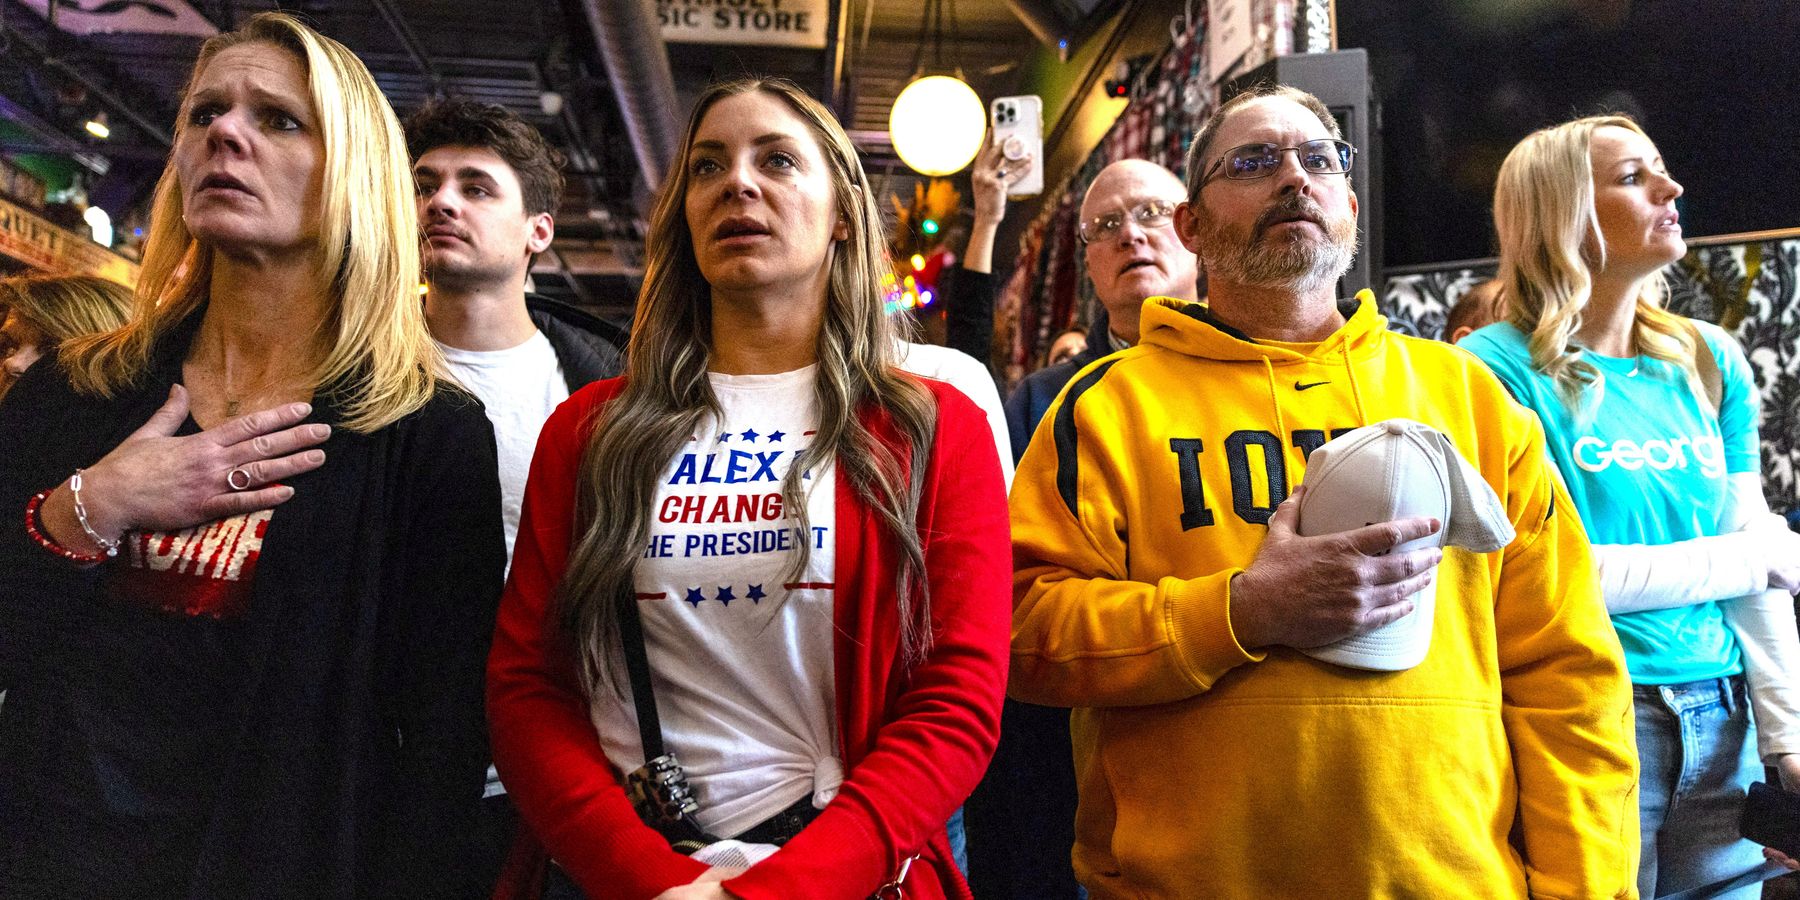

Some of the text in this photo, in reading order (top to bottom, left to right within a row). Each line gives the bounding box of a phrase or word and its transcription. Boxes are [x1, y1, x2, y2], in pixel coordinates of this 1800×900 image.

[713, 9, 811, 33] STORE
[1572, 434, 1726, 479] Georg
[1170, 428, 1360, 532] IO
[644, 527, 829, 559] HE PRESIDENT
